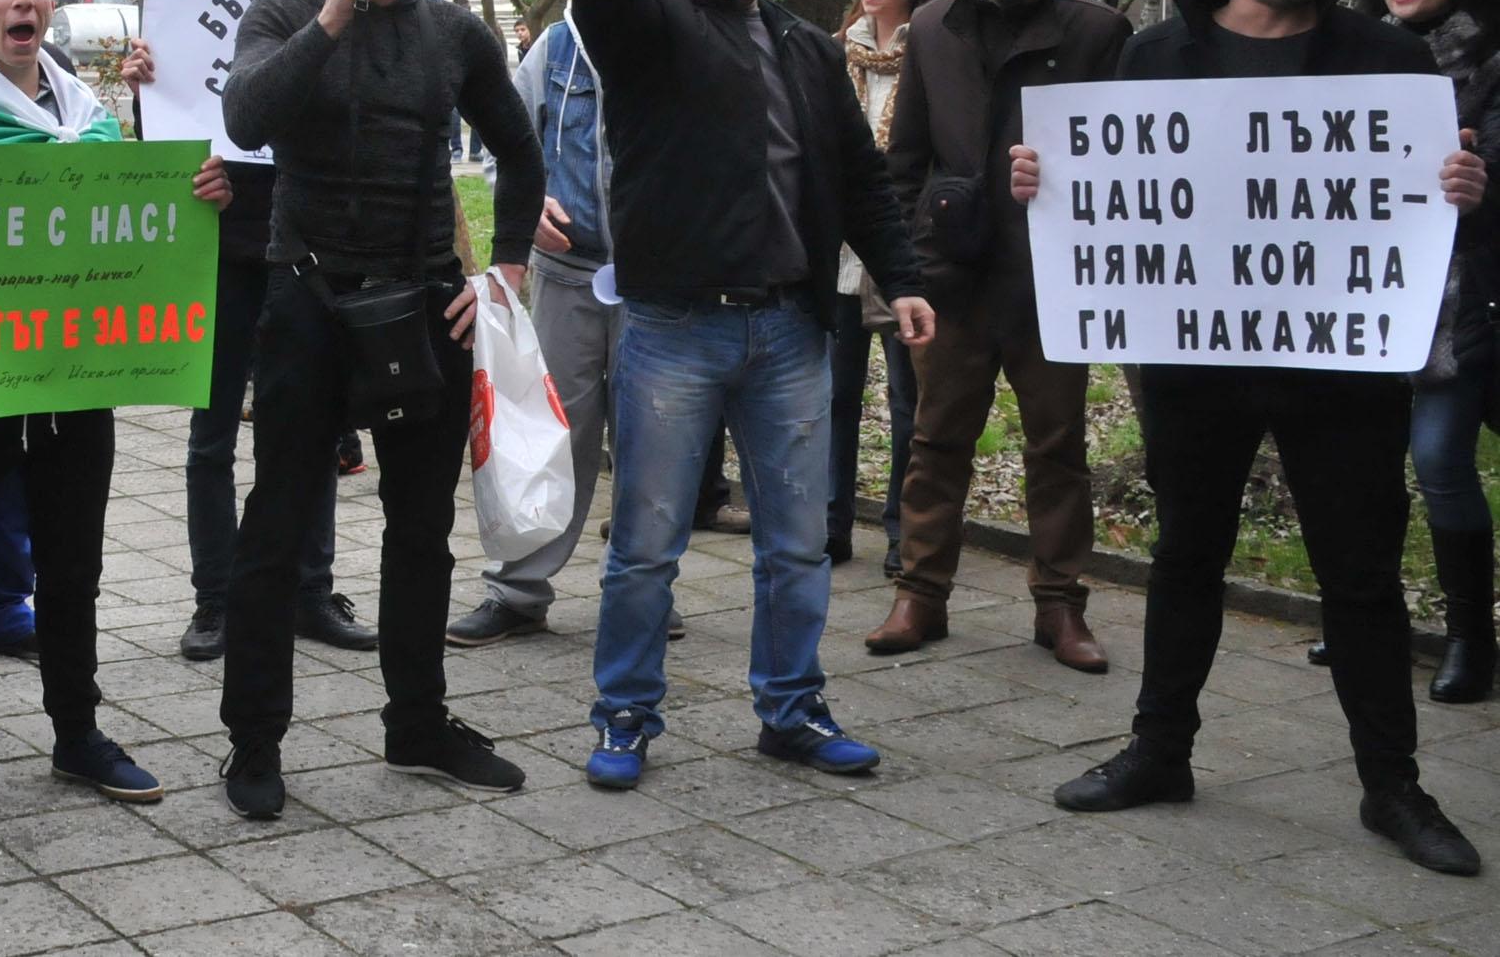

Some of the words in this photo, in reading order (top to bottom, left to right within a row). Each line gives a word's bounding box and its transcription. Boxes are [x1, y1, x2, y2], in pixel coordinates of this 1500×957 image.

[1069, 111, 1190, 156] БОКО
[1246, 109, 1412, 159] ЛЪЖЕ,
[48, 207, 66, 247] С
[91, 202, 177, 244] НАС!
[1072, 177, 1195, 226] ЦАЦО
[1073, 243, 1198, 287] НЯМА
[1232, 240, 1316, 287] КОЙ
[1347, 245, 1406, 295] ДА
[63, 308, 81, 348] Е
[93, 305, 129, 347] ЗА
[139, 301, 206, 343] ВАС
[1078, 308, 1128, 351] ГИ
[1176, 308, 1391, 358] НАКАЖЕ!
